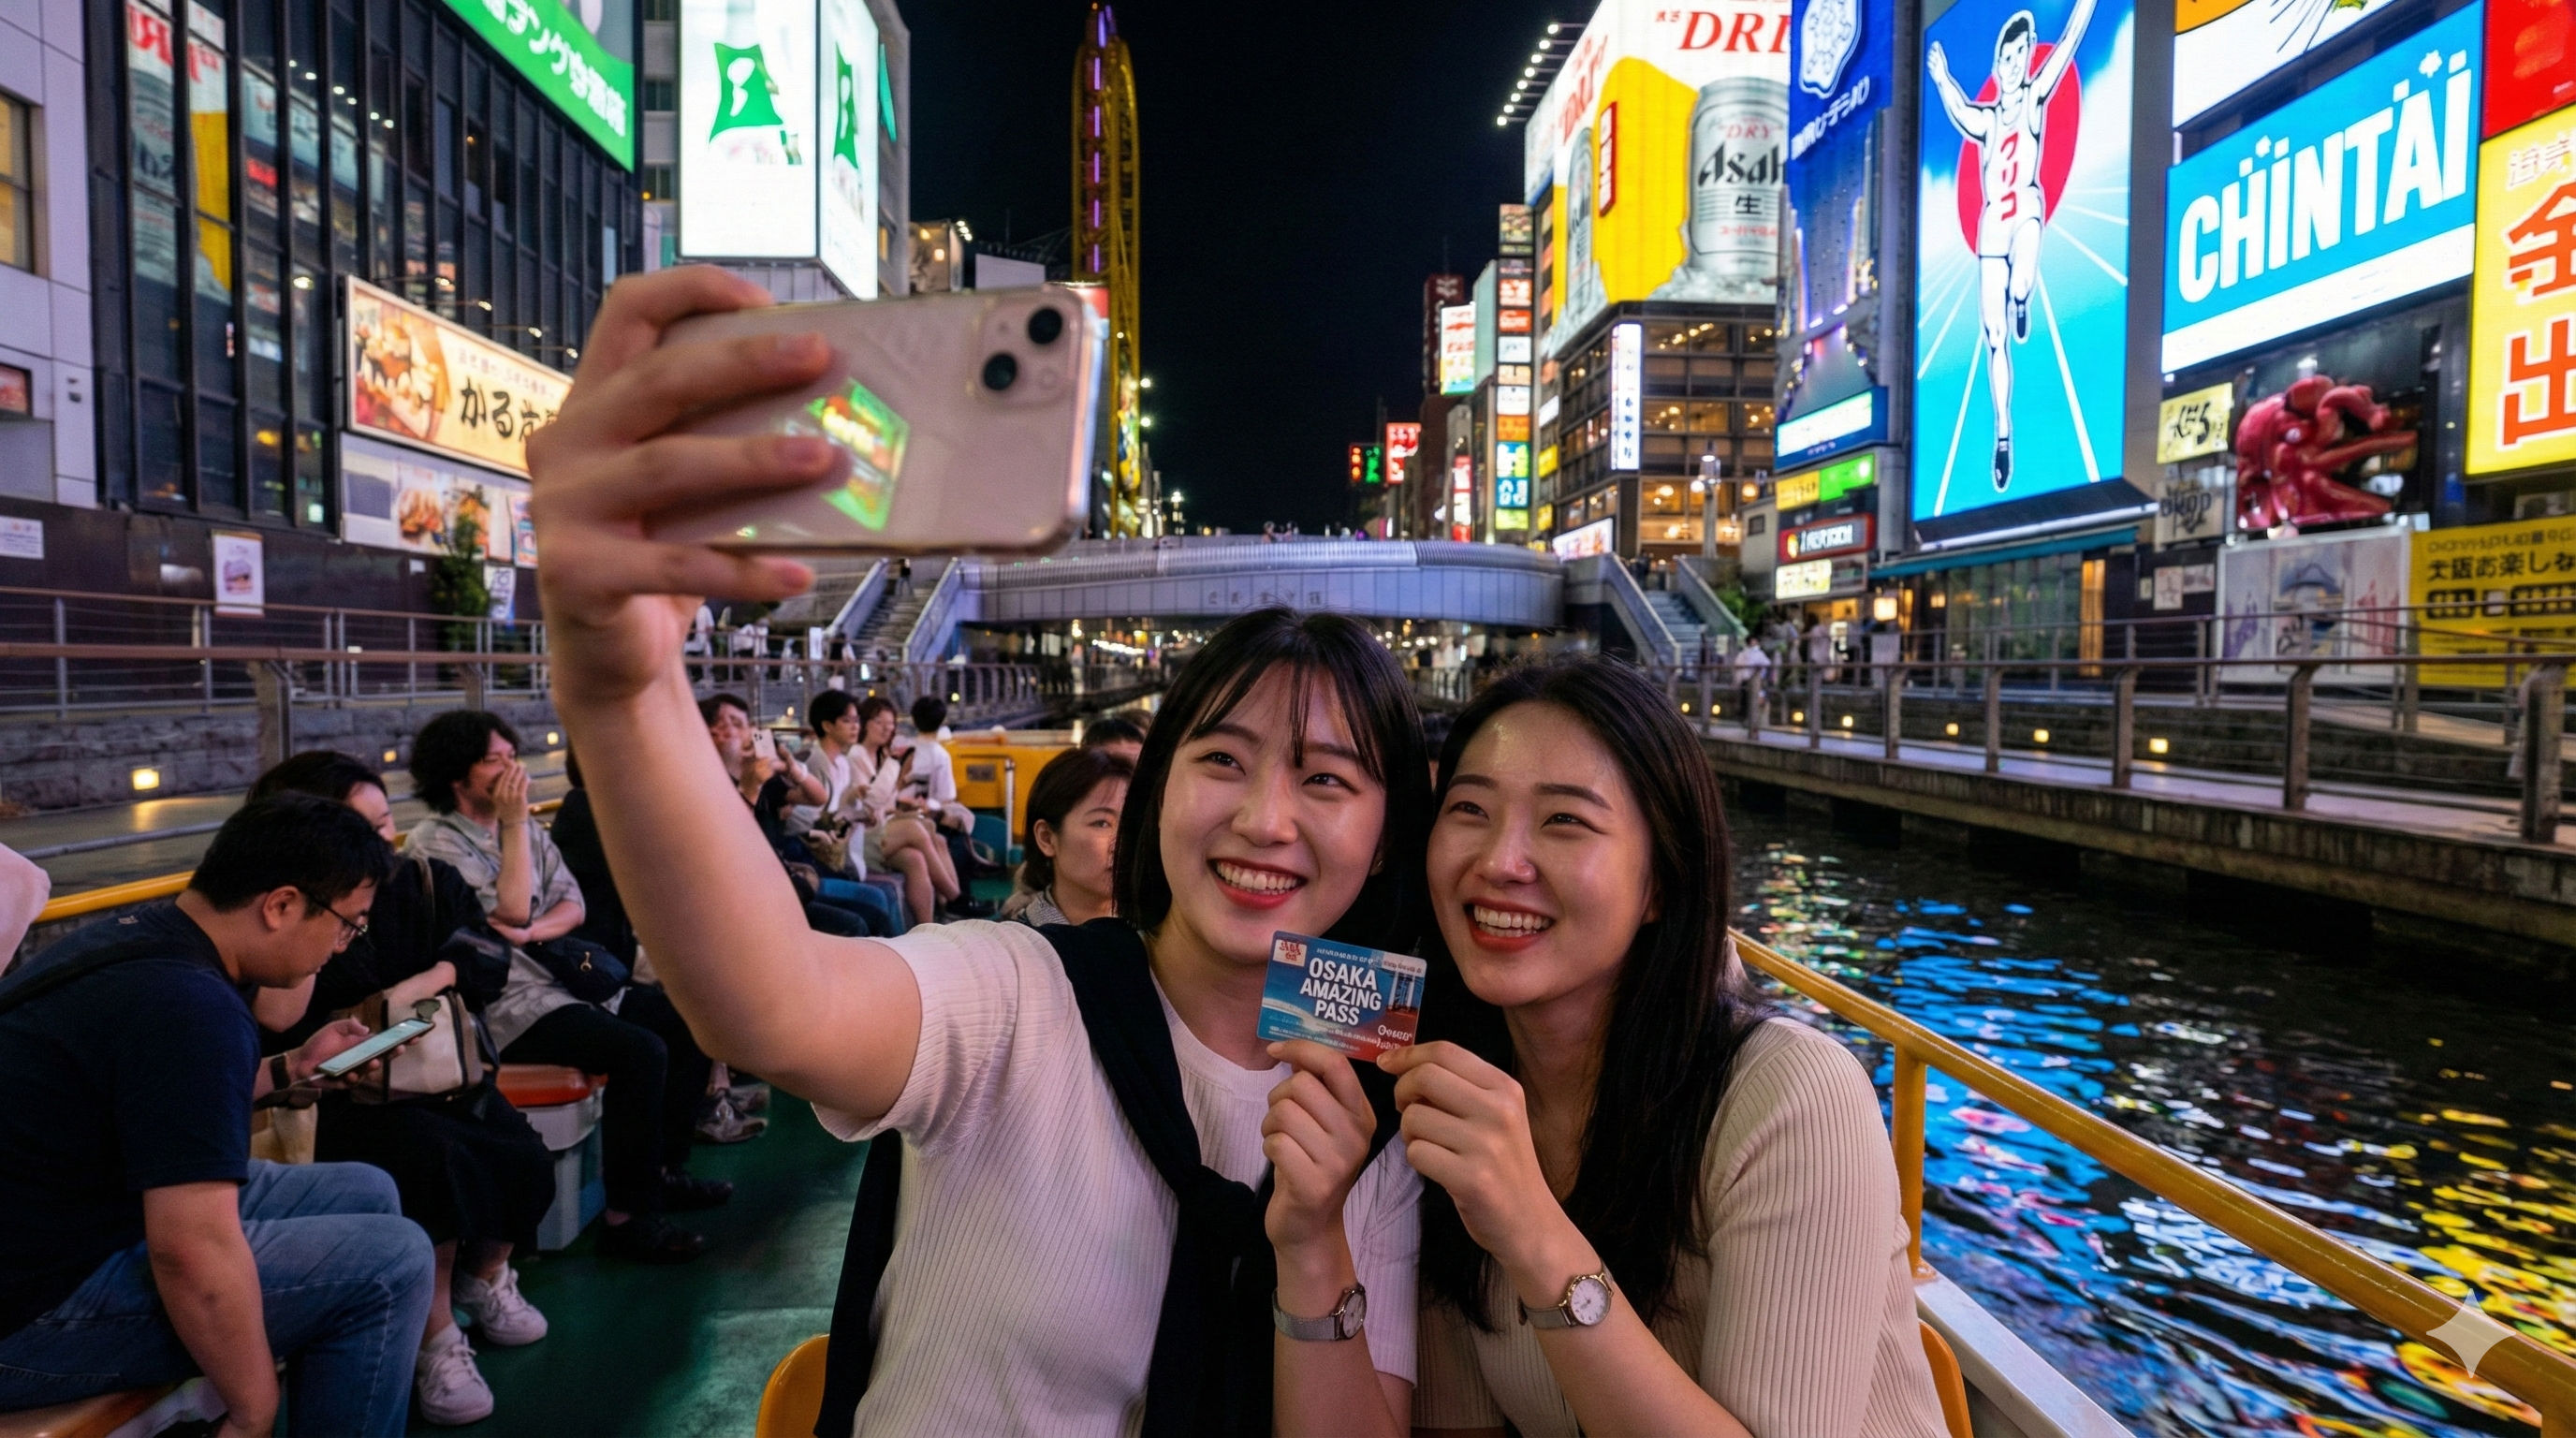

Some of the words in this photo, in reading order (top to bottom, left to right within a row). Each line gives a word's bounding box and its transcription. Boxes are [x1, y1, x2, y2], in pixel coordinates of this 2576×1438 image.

[1734, 195, 1763, 215] 生
[1309, 957, 1377, 990] OSAKA
[1299, 977, 1383, 1011] AMAZING
[1314, 999, 1360, 1026] PASS
